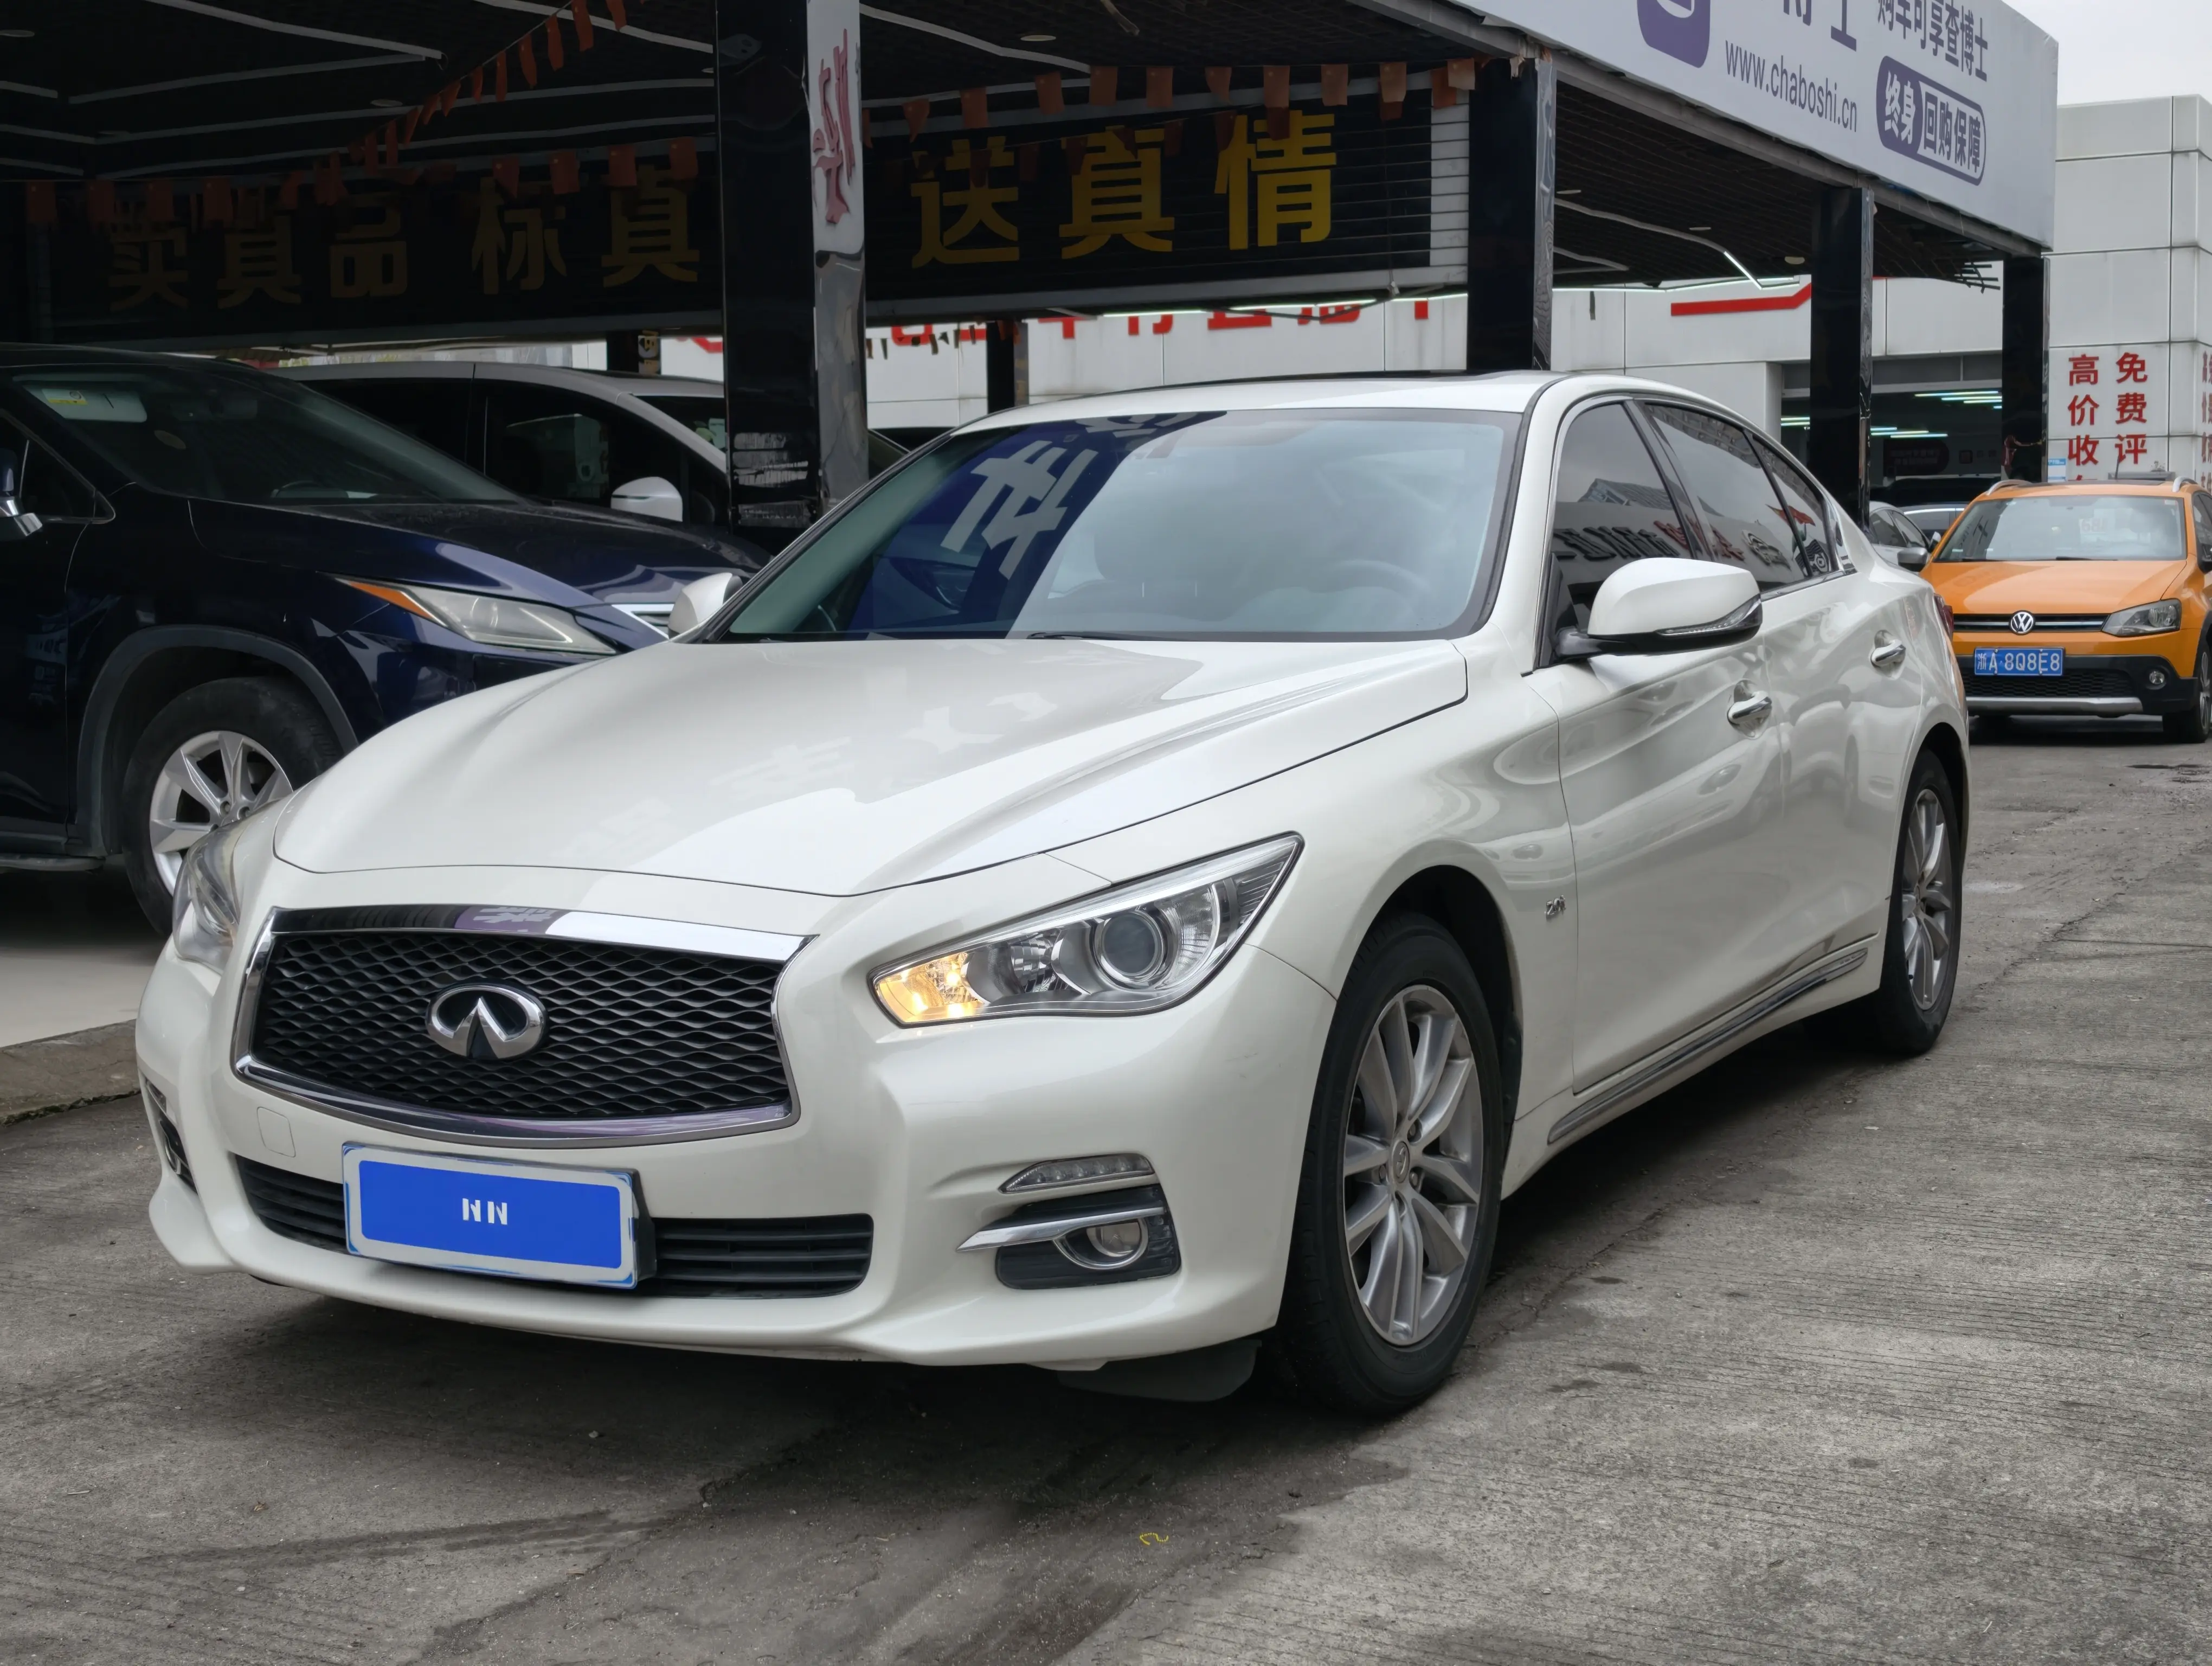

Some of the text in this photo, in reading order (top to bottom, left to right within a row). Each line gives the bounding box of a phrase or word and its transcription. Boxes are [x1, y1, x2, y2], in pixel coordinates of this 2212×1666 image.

[1726, 40, 1857, 132] www.chaboshi.cn
[1885, 71, 1981, 173] 终身 回购保障
[910, 110, 1337, 269] 送真情
[2067, 354, 2099, 481] 高价收
